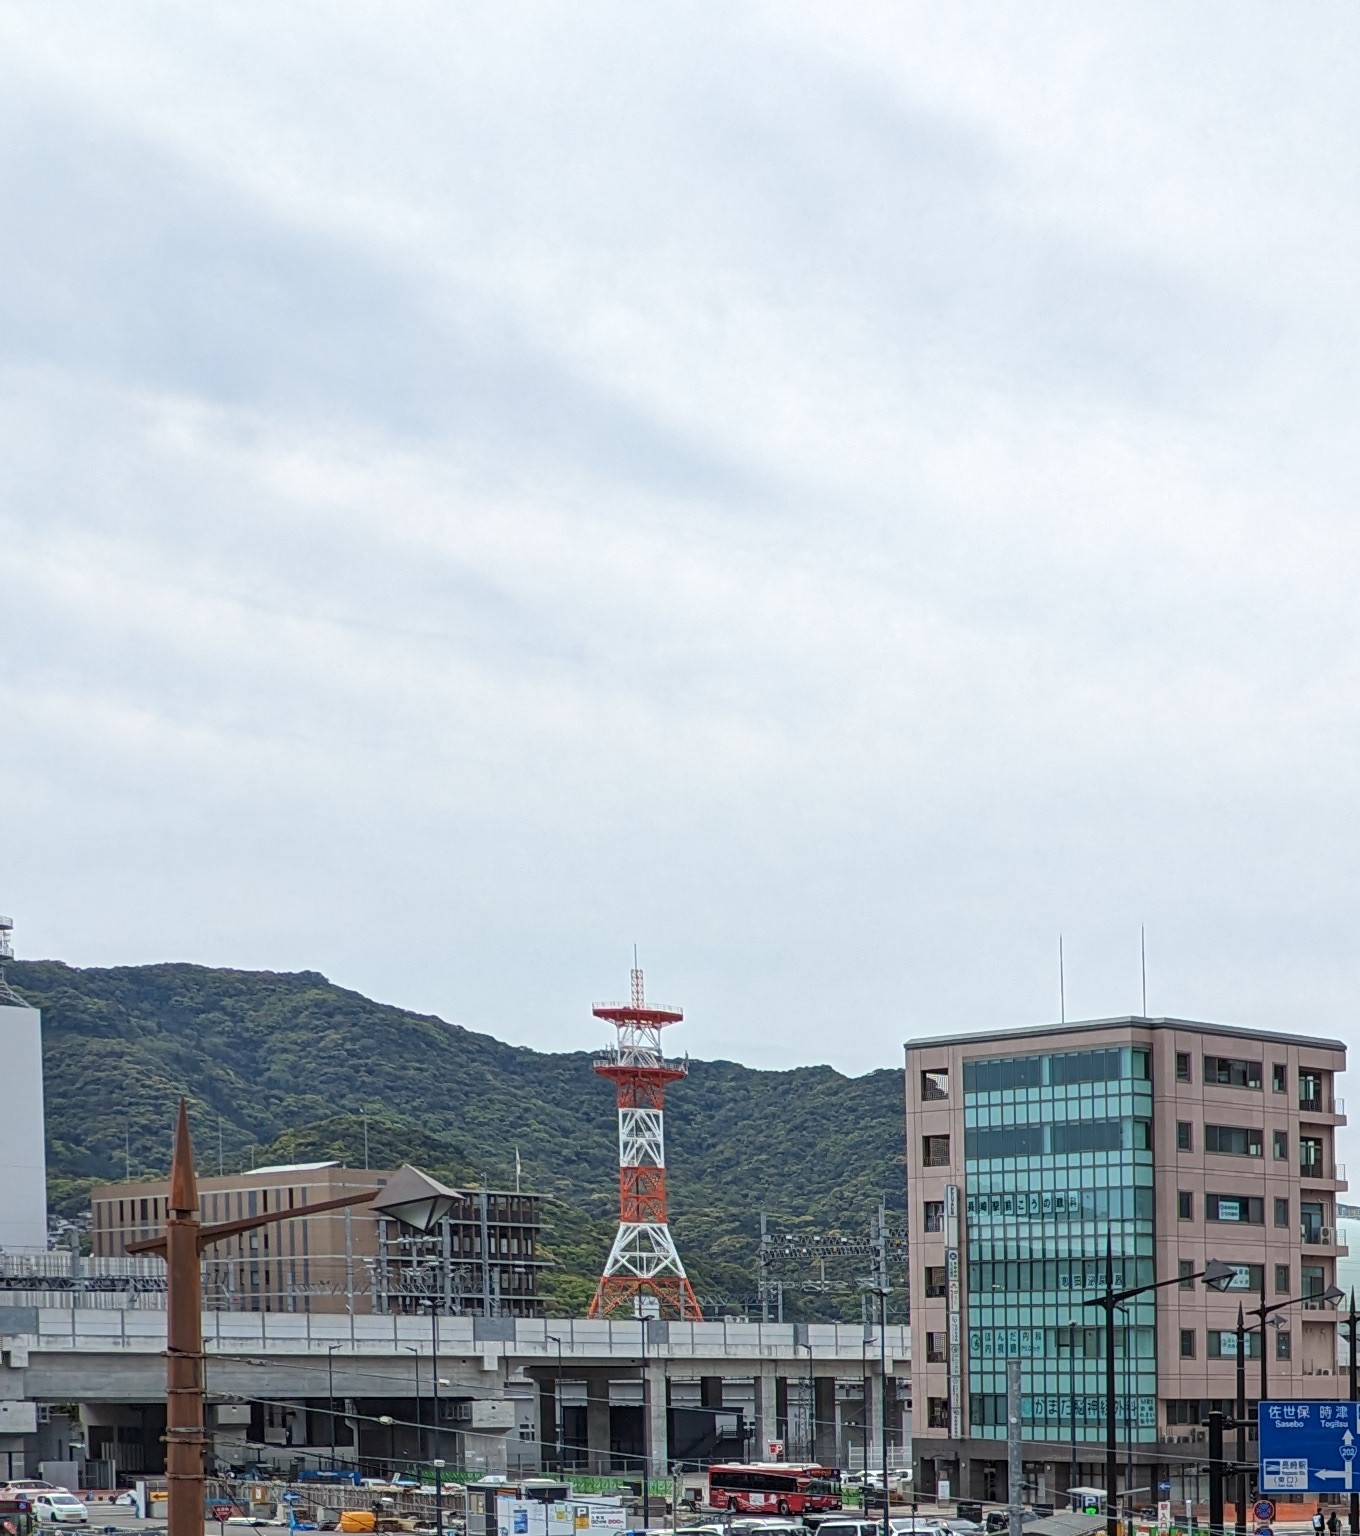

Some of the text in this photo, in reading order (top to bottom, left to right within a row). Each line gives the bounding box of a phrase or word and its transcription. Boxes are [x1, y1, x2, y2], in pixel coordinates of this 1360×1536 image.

[1267, 1405, 1349, 1420] 佐世保 時津
[1274, 1419, 1349, 1430] Sasebo Togitsu
[1341, 1448, 1355, 1456] 202
[1084, 1496, 1096, 1507] P
